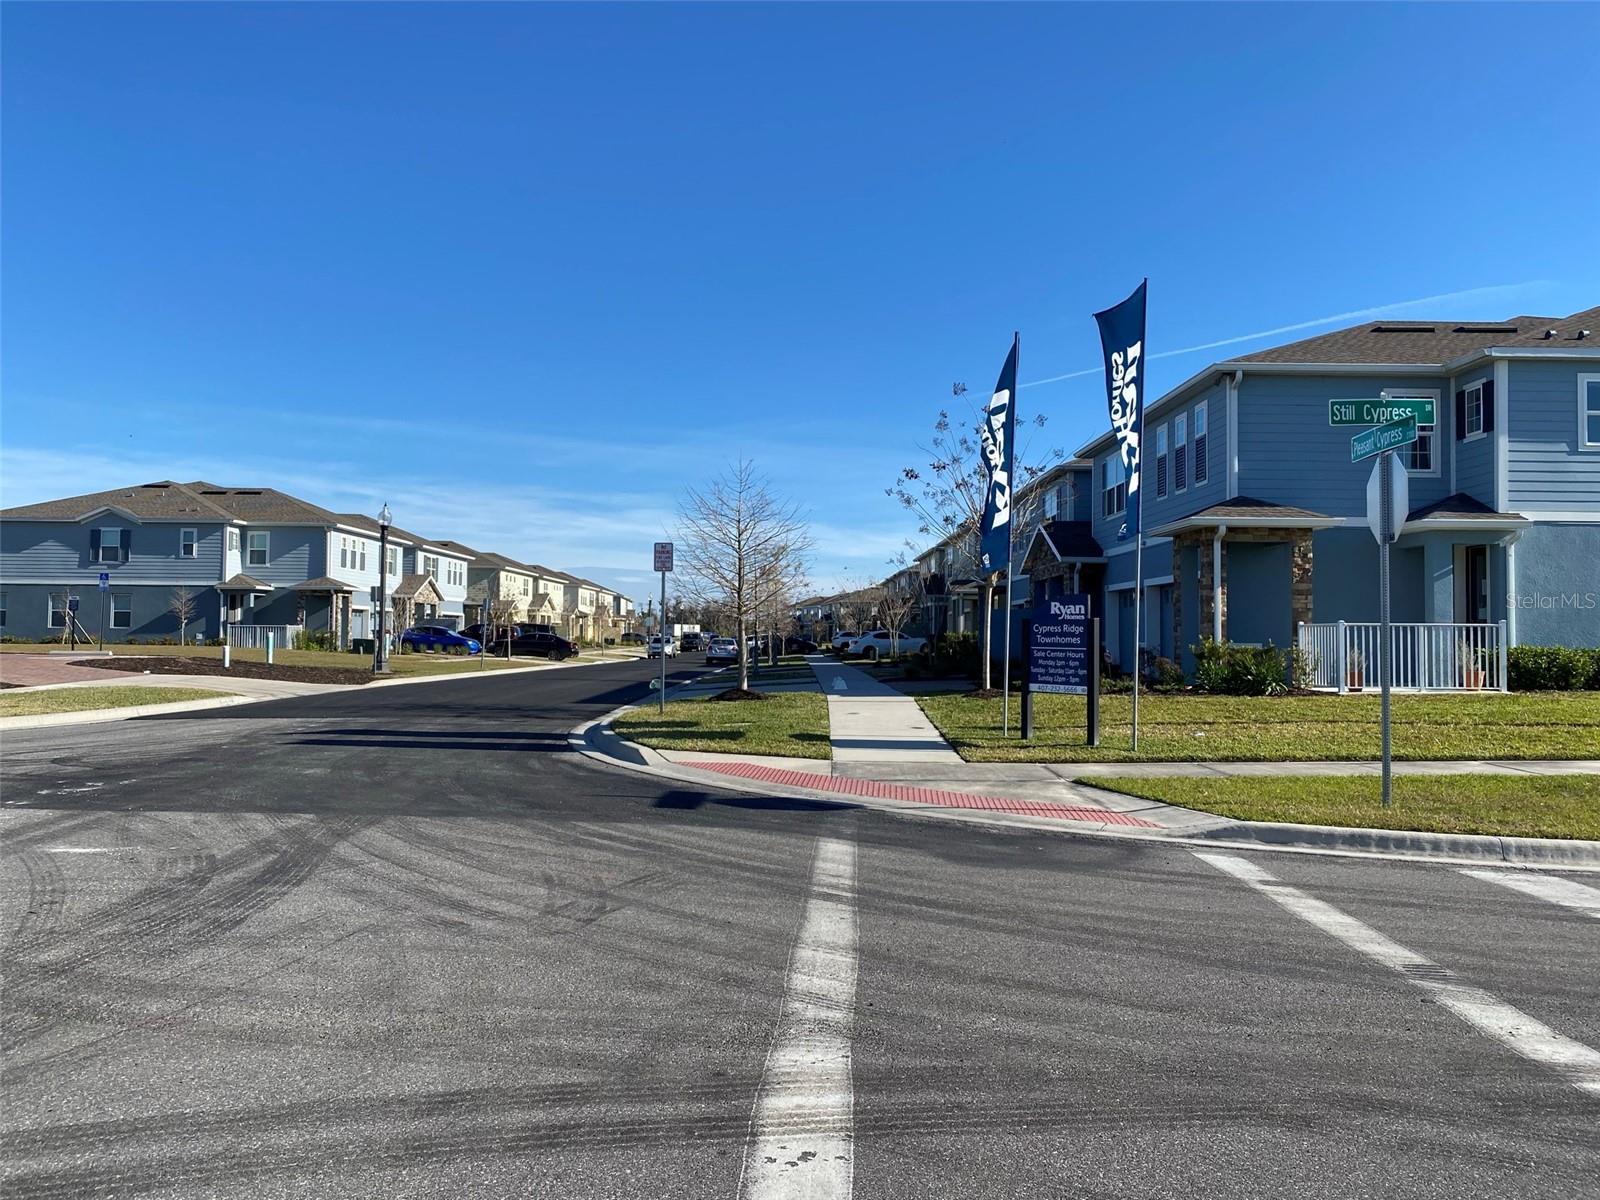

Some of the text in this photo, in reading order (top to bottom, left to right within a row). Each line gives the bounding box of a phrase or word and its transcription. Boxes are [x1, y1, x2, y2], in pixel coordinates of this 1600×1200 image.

[1333, 404, 1356, 421] Still
[1363, 404, 1412, 423] Cypress
[1353, 437, 1375, 457] Pleasant
[1377, 427, 1403, 448] Cypress
[1050, 601, 1085, 620] Ryan
[1033, 624, 1084, 635] Cypress Ridge
[1036, 635, 1081, 644] Townhomes
[1046, 650, 1066, 658] Center
[1038, 659, 1056, 667] Monday
[1037, 674, 1053, 682] Sunday
